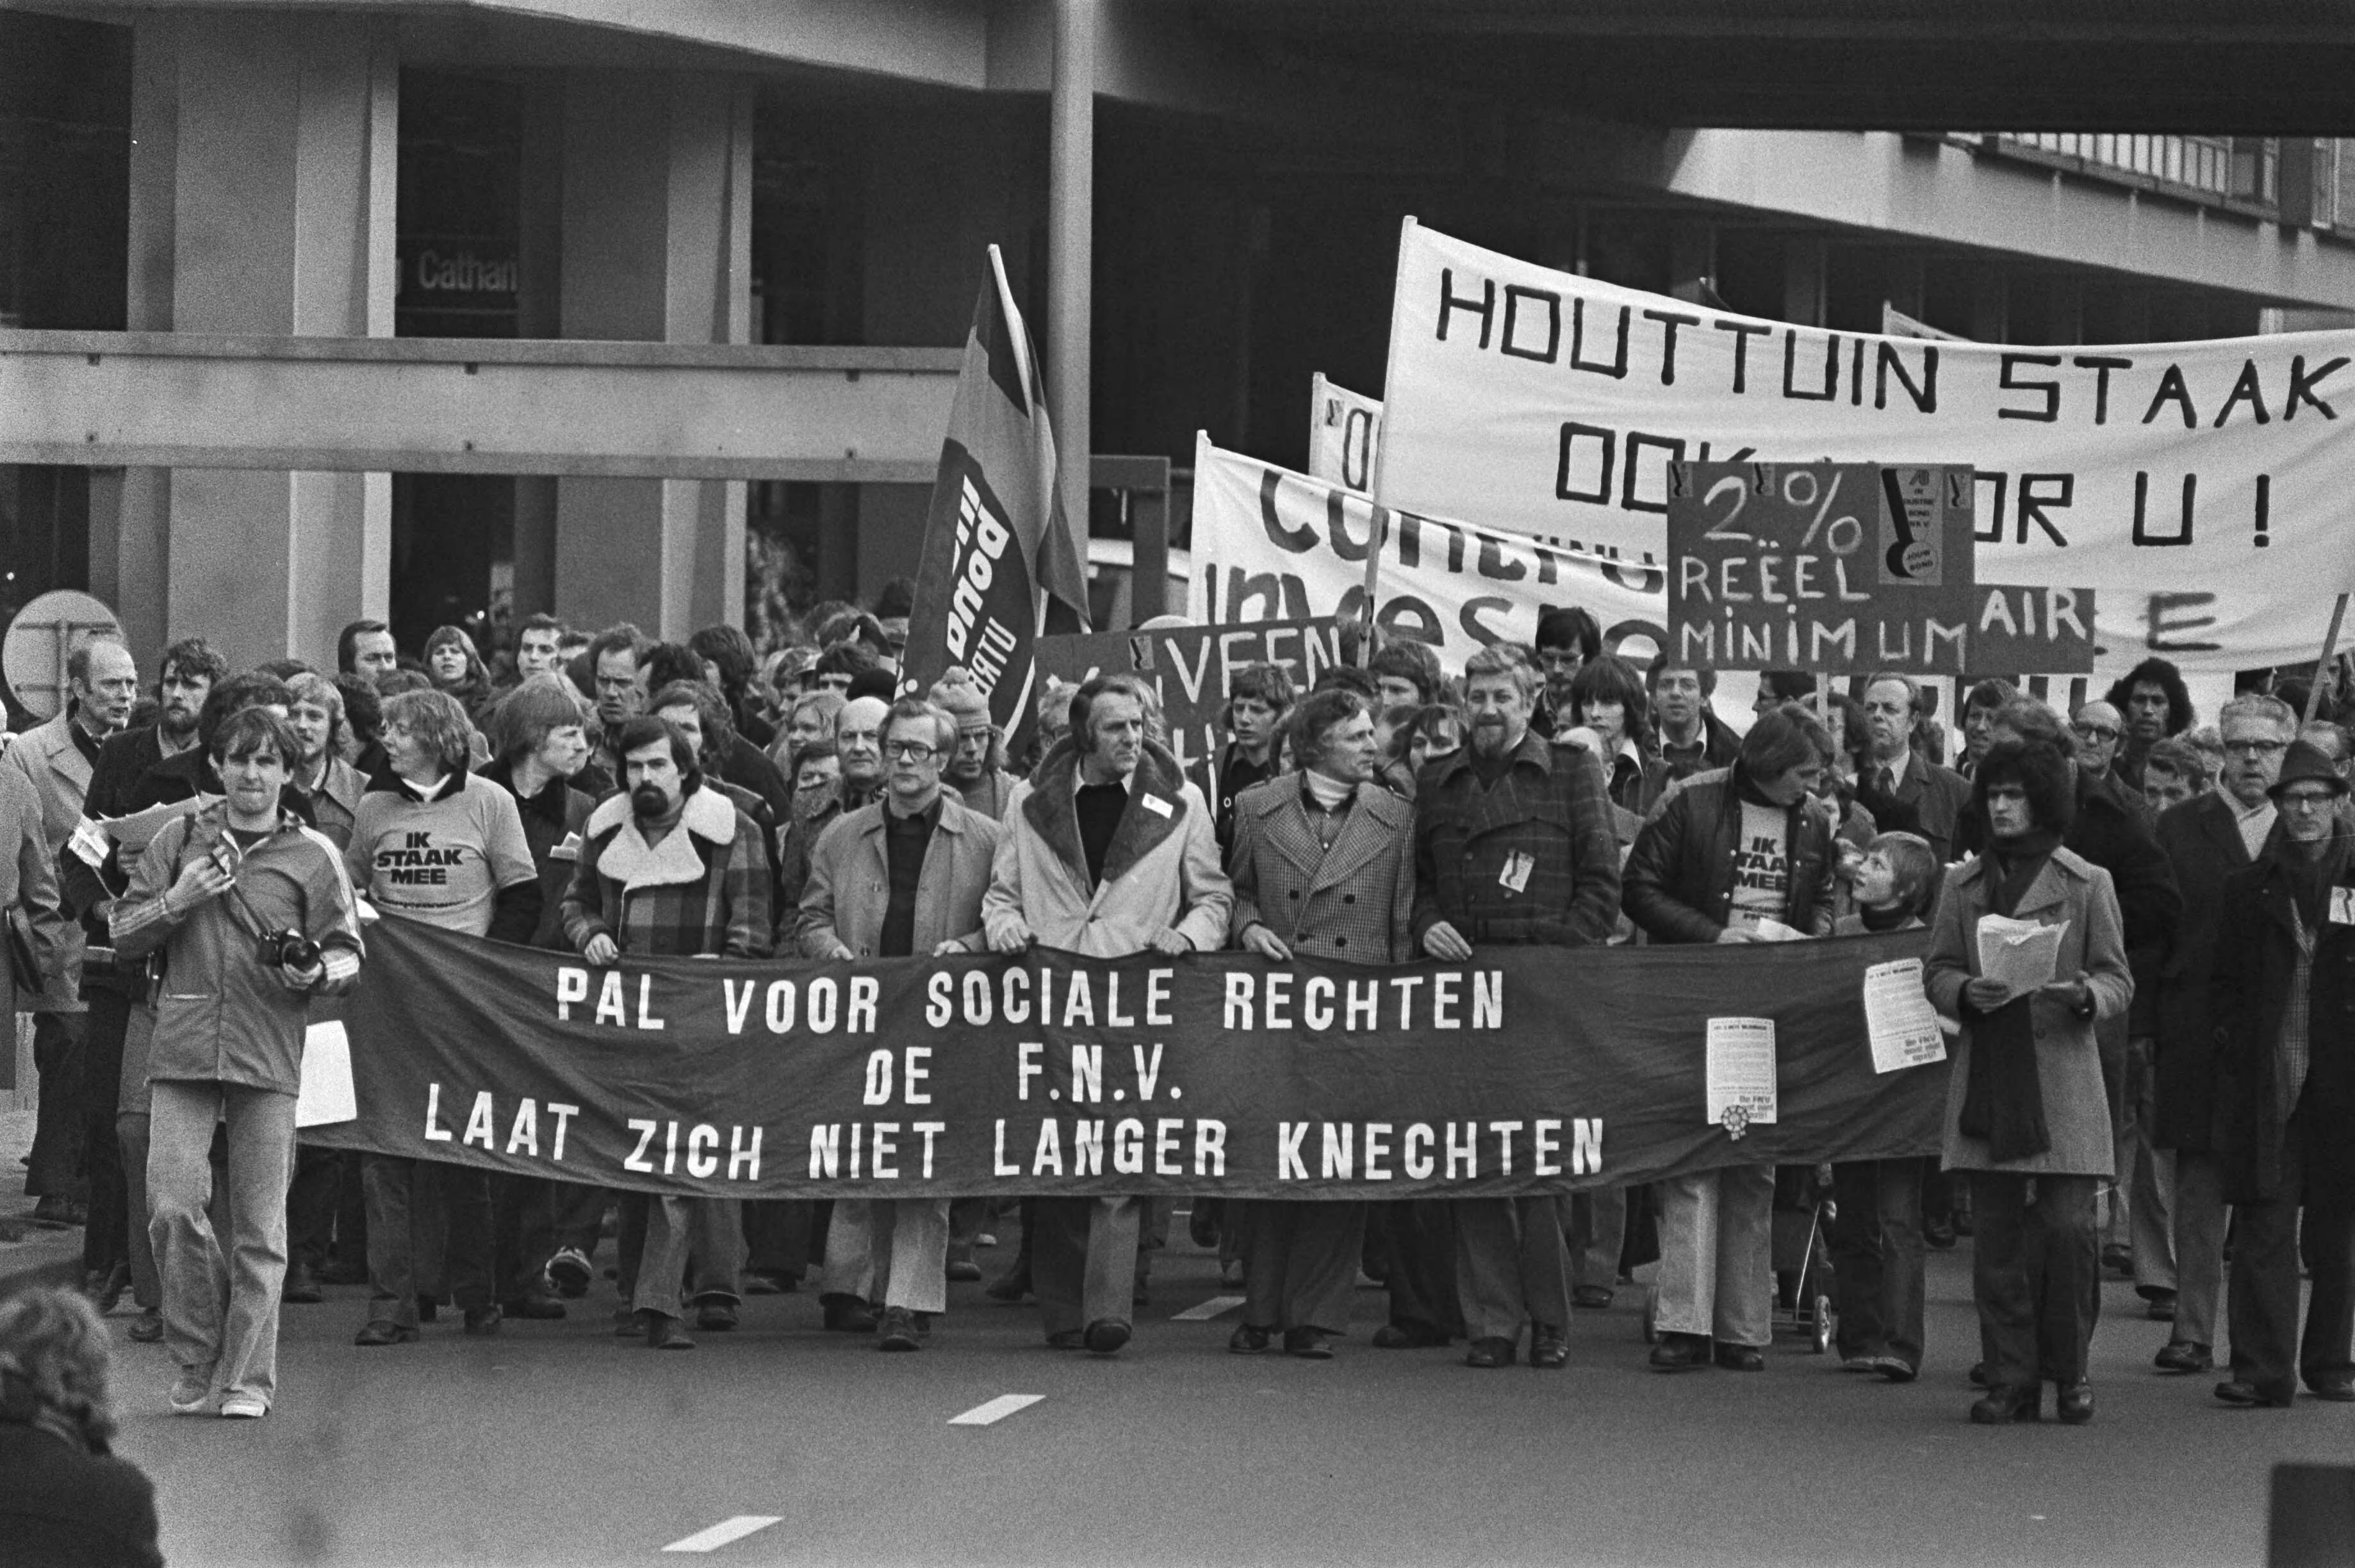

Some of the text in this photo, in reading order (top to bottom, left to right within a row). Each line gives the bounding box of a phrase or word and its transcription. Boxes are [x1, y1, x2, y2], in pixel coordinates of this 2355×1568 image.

[1436, 267, 2352, 429] HOUTTUIN STAAK
[2132, 471, 2197, 546] U
[377, 849, 464, 867] STAAK
[406, 831, 432, 849] IK
[1752, 836, 1777, 854] IK
[390, 868, 447, 885] MEE
[556, 966, 1503, 1034] PAL VOOR SOCIALE RECHTEN
[863, 1042, 1182, 1106] DE F.N.V.
[423, 1082, 1604, 1180] LAAT ZICH NIET LANGER KNECHTEN
